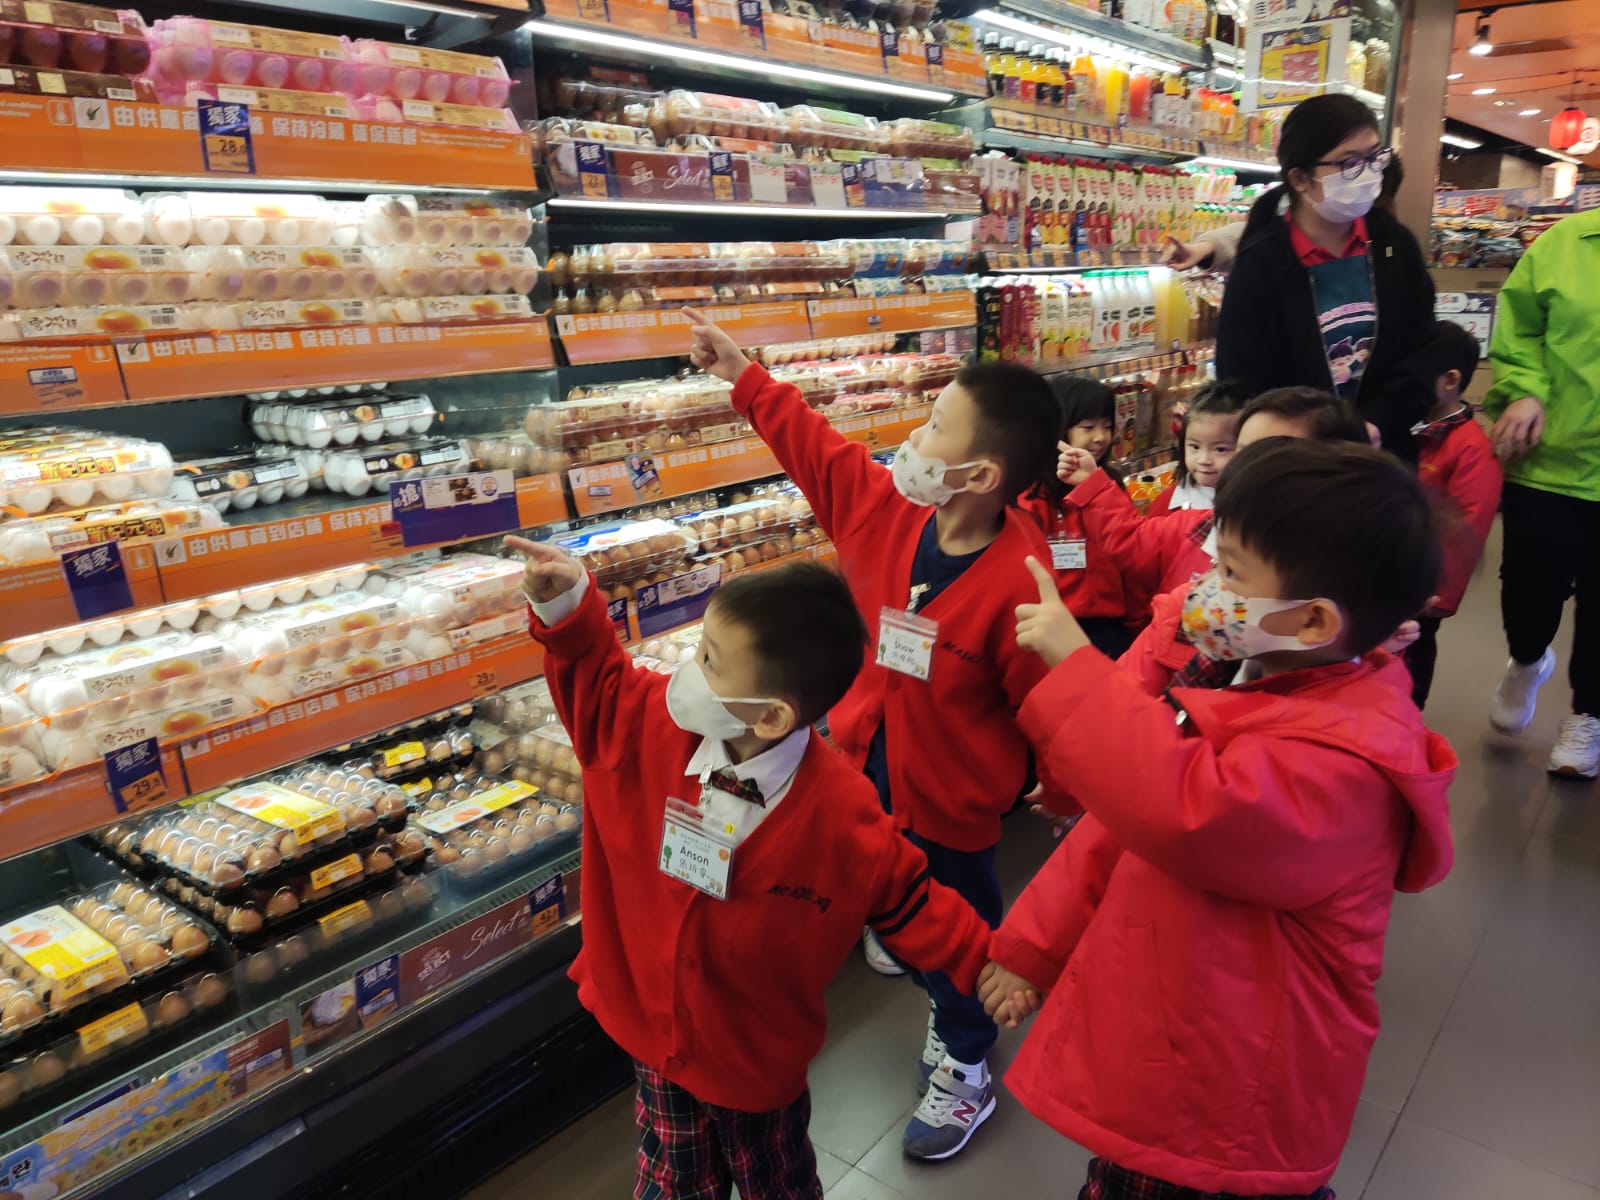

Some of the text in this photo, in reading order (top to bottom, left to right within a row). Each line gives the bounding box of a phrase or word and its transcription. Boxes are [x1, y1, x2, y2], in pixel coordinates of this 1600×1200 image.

[207, 105, 243, 126] 獨家
[189, 518, 324, 556] 由供應商到店舖
[73, 545, 112, 576] 獨家
[115, 741, 151, 771] 獨家
[680, 845, 709, 866] Anson
[463, 910, 521, 960] Select
[417, 949, 452, 982] SELECT
